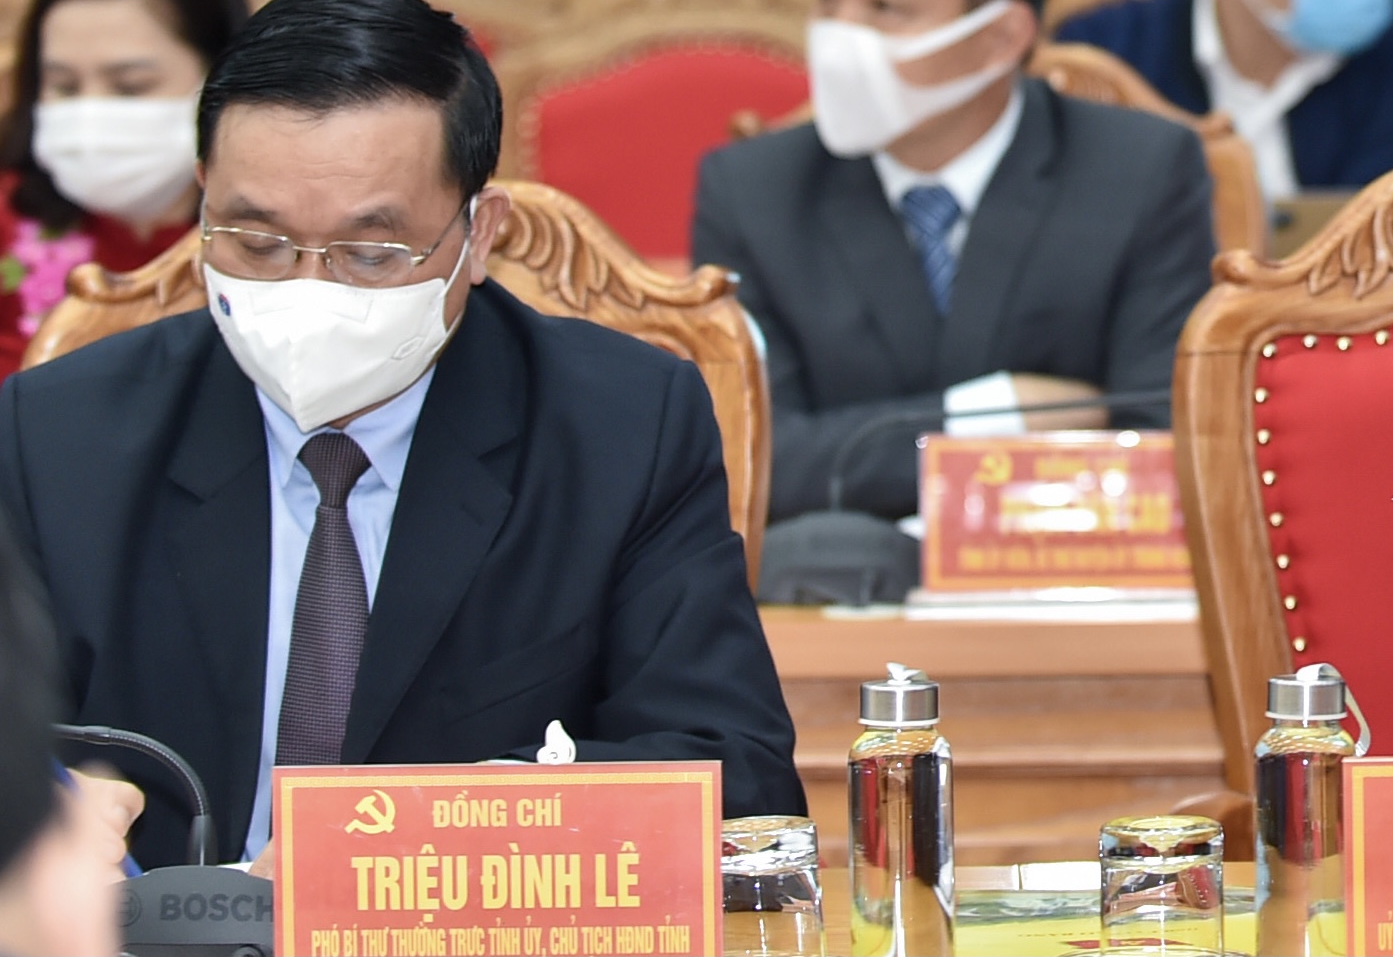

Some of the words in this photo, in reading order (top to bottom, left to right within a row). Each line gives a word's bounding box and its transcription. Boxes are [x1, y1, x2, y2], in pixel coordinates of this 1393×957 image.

[432, 789, 508, 828] ĐỒNG
[517, 793, 562, 827] CHÍ
[351, 844, 468, 922] TRIỆU
[480, 843, 581, 909] ĐÌNH
[594, 841, 641, 907] LÊ
[160, 893, 273, 923] BOSCH
[311, 924, 340, 957] PHÓ
[343, 924, 358, 957] BÍ
[361, 926, 390, 956] THƯ
[391, 921, 446, 956] THƯỜNG
[488, 917, 521, 955] TỈNH
[550, 915, 578, 955] CHỦ
[615, 926, 654, 954] HĐND
[657, 915, 690, 954] TỈNH
